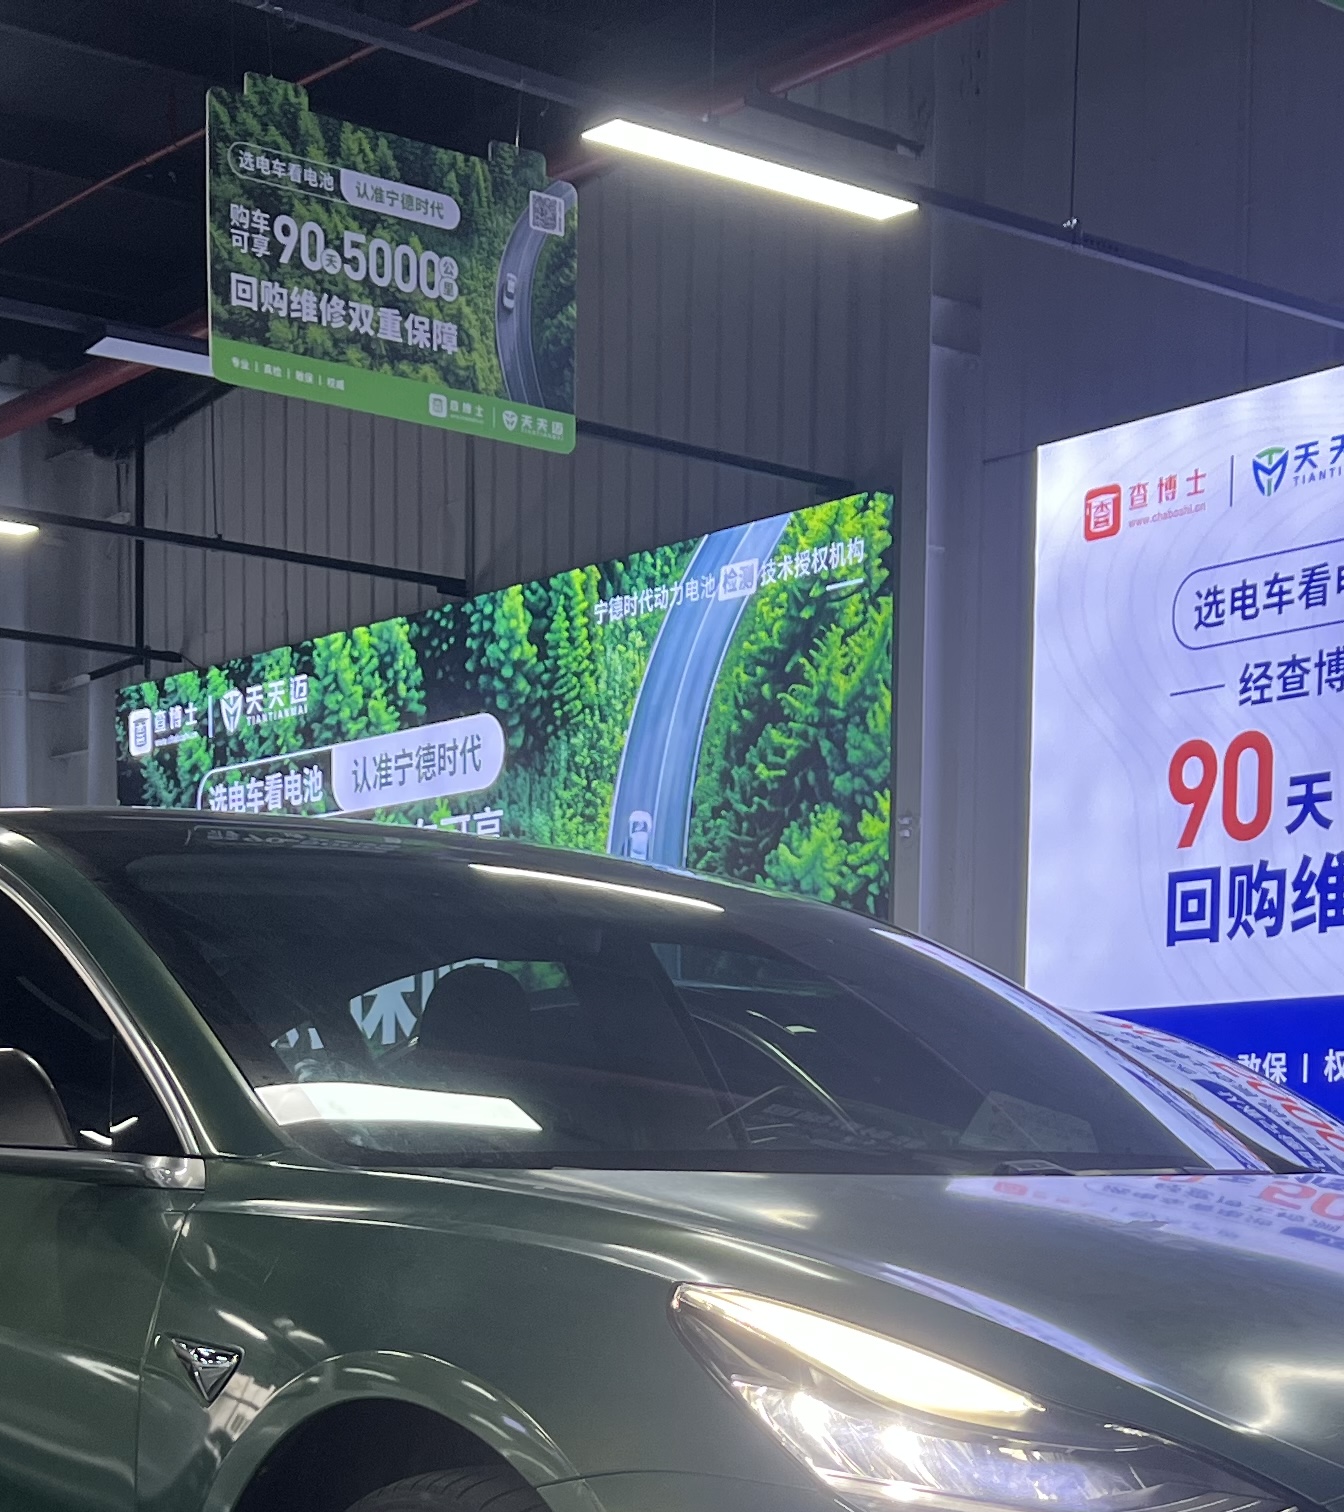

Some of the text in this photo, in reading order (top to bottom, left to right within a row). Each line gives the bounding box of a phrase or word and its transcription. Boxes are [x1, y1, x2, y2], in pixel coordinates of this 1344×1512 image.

[239, 151, 444, 219] 选电车看电池 认准宁德时代
[230, 204, 270, 233] 购车
[230, 230, 270, 257] 可享
[231, 272, 457, 354] 回购维修双重保障
[1129, 468, 1206, 510] 查博士
[1128, 502, 1207, 527] www.chaboshi.cn
[246, 673, 308, 714] 天天迈
[352, 734, 481, 793] 认准宁德时代
